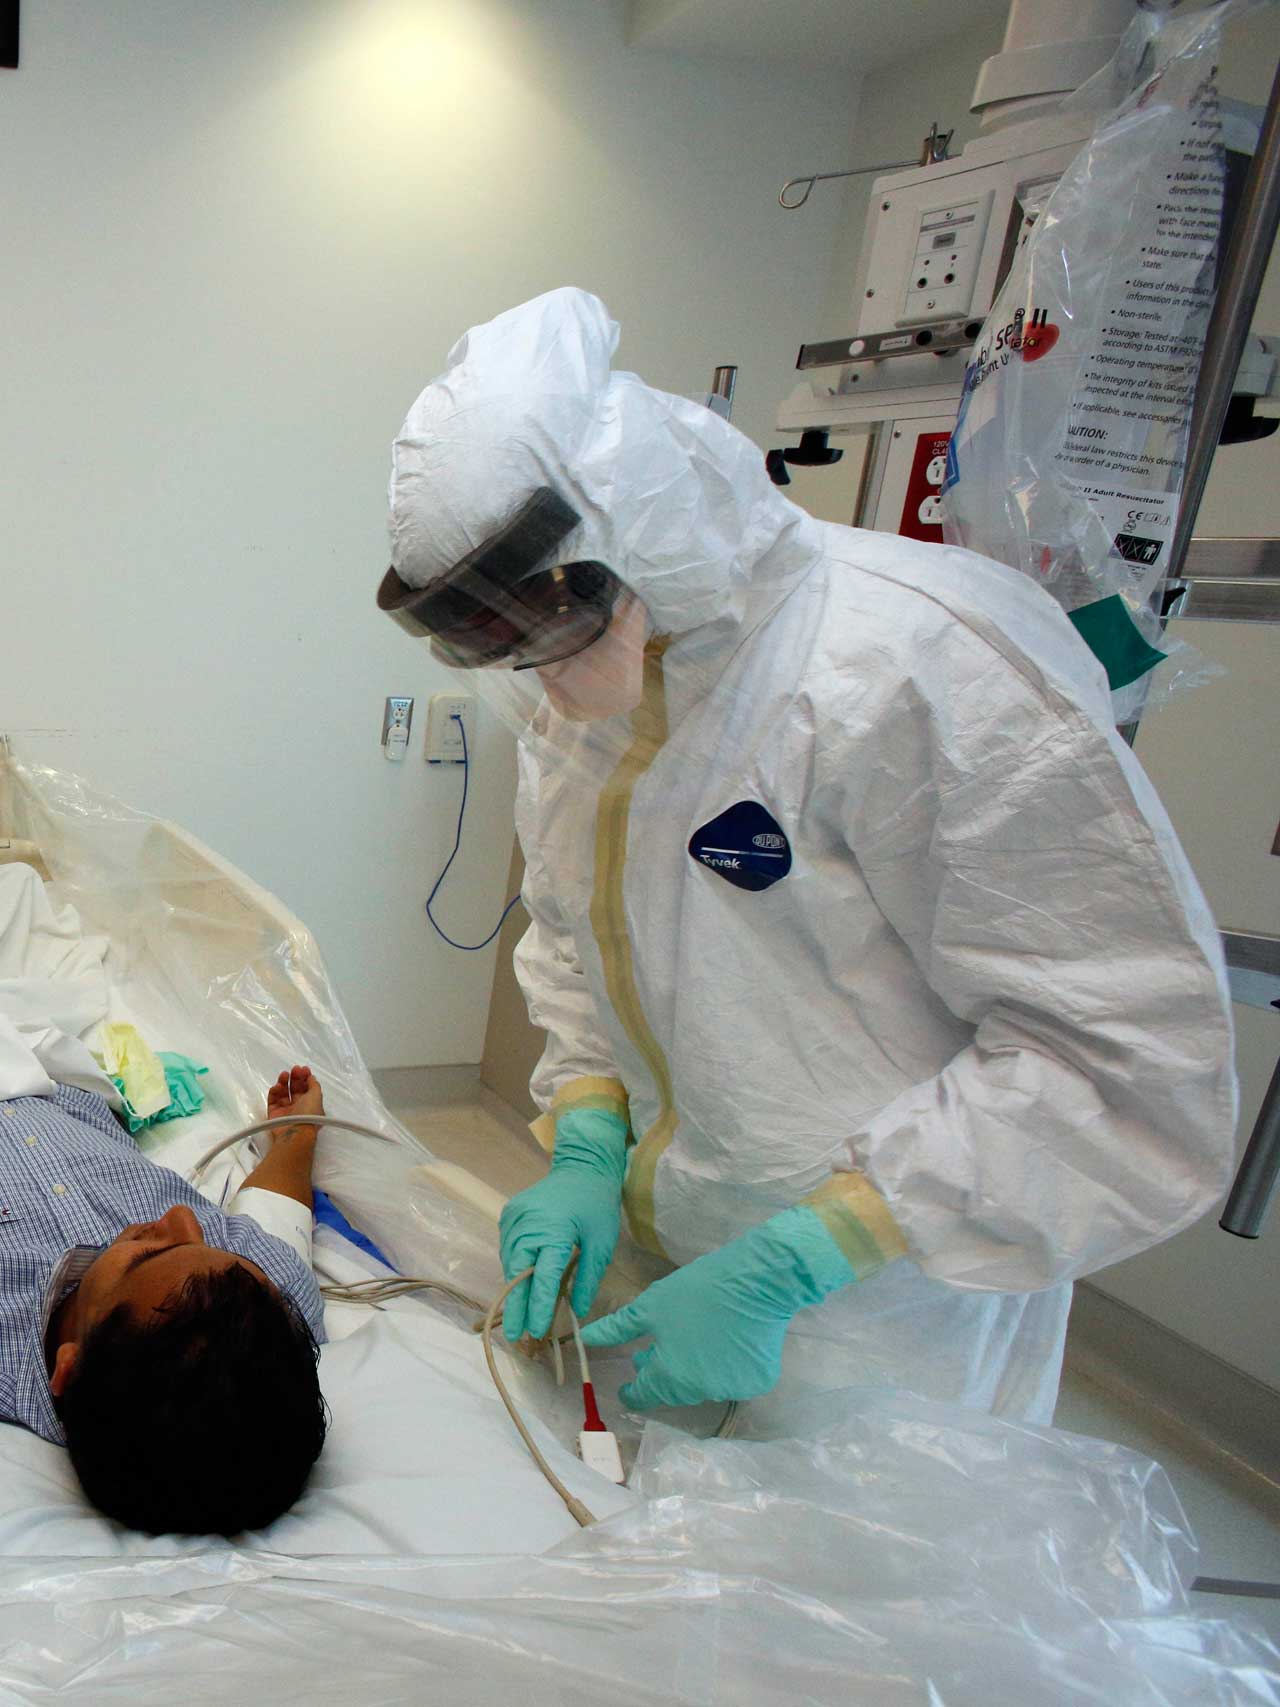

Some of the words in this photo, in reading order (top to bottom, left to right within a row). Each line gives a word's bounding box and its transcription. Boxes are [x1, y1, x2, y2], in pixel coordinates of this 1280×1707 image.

[1148, 246, 1169, 256] Make
[1132, 279, 1154, 289] Users
[1155, 281, 1165, 289] of
[1165, 283, 1180, 292] this
[1126, 292, 1171, 305] information
[1181, 299, 1194, 307] the
[1117, 308, 1162, 321] Non-sterile.
[1108, 327, 1141, 339] Storage:
[1144, 331, 1168, 341] Tested
[1102, 340, 1142, 352] according
[1144, 344, 1153, 352] to
[1153, 345, 1178, 354] ASTM
[1095, 354, 1135, 368] Operating
[1090, 372, 1102, 380] The
[1102, 374, 1136, 388] integrity
[1137, 378, 1147, 388] of
[1148, 381, 1162, 390] kits
[1163, 384, 1189, 394] issued
[1120, 390, 1129, 398] at
[1130, 391, 1144, 400] the
[1145, 394, 1175, 404] interval
[1122, 410, 1137, 418] see
[1091, 445, 1106, 455] law
[1107, 449, 1138, 461] restricts
[1139, 454, 1154, 464] this
[1095, 459, 1105, 467] of
[1111, 462, 1151, 476] physician.
[1093, 488, 1115, 497] Adult
[1116, 492, 1165, 505] Resuscitator
[700, 854, 744, 869] Tyvek
